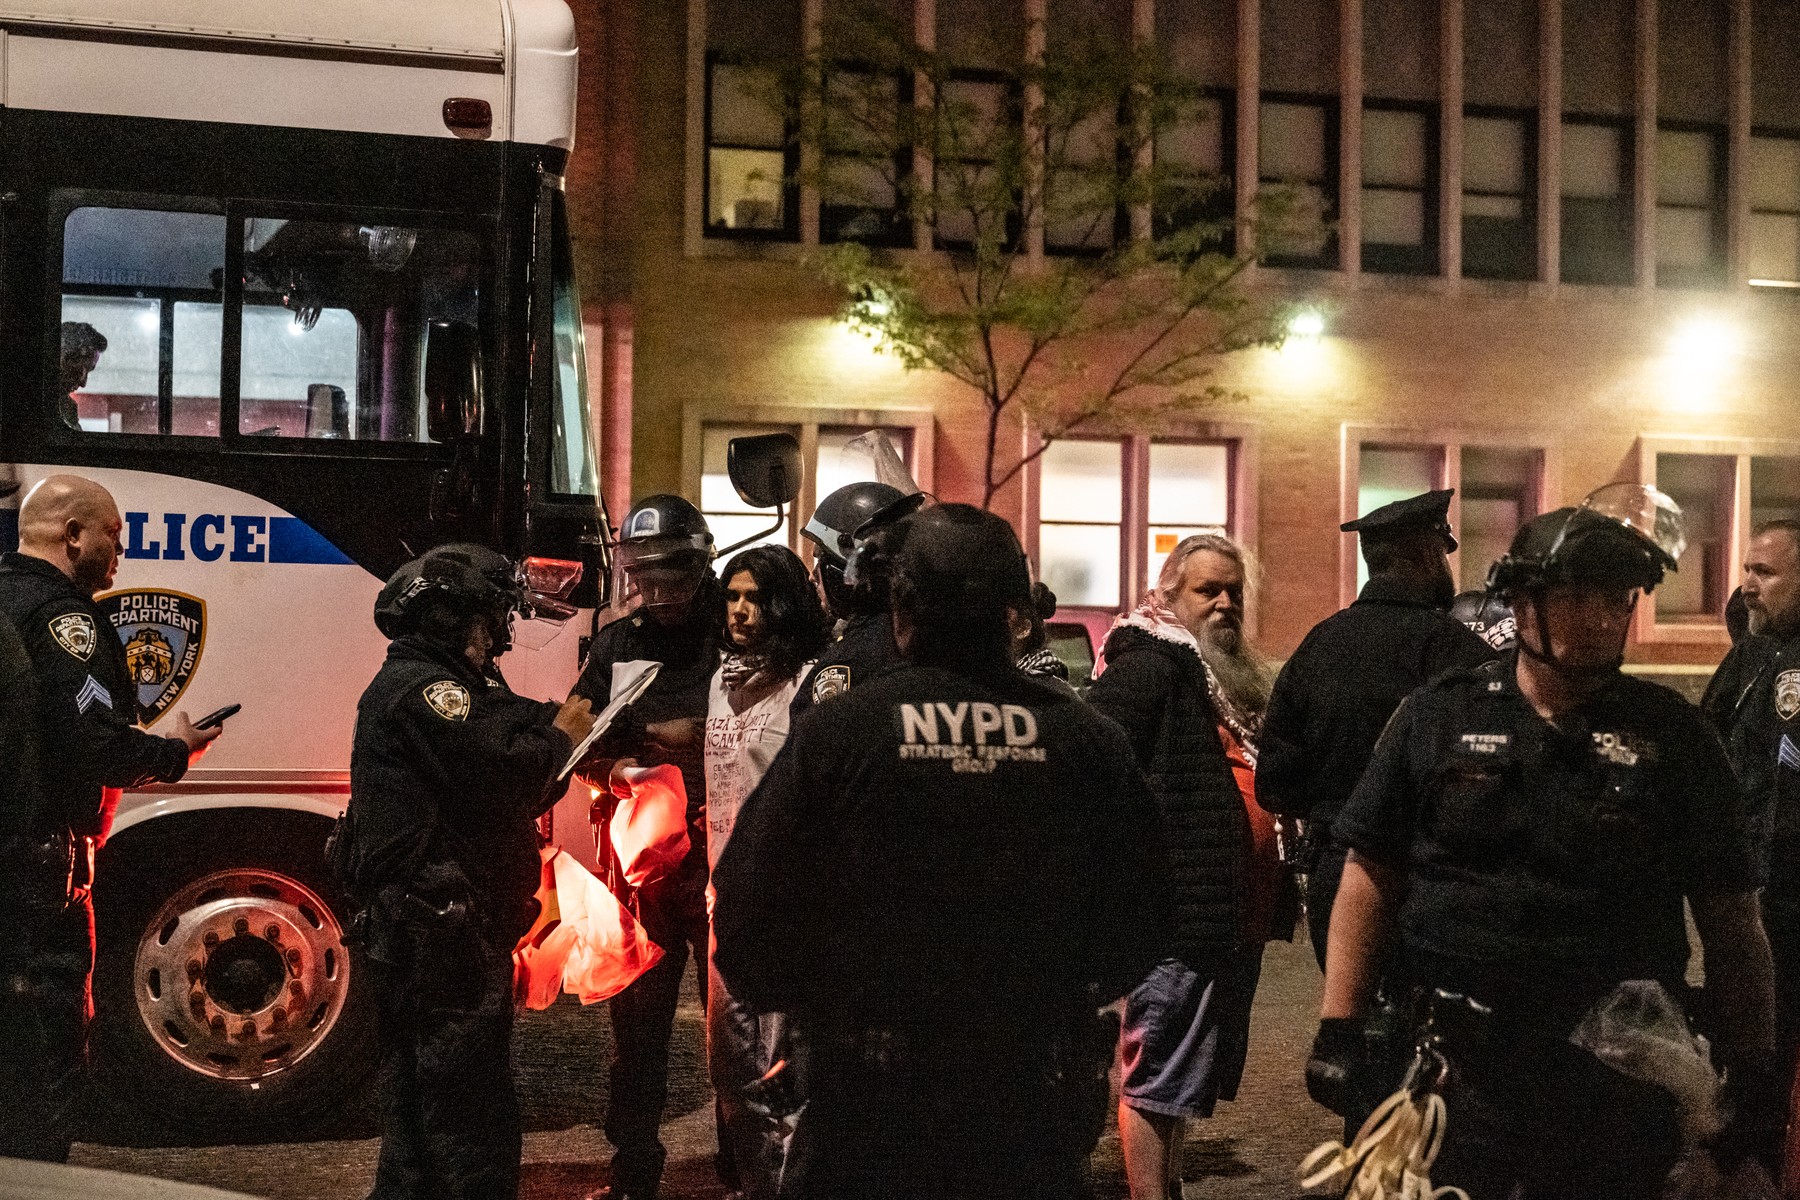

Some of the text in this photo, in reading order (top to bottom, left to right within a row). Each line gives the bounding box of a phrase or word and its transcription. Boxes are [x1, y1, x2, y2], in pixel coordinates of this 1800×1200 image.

[124, 512, 267, 563] LICE
[120, 595, 180, 612] POLICE
[109, 609, 200, 634] EPARTMENT
[1463, 621, 1485, 631] 73
[155, 642, 199, 710] NEW YORK
[900, 702, 1038, 746] NYPD
